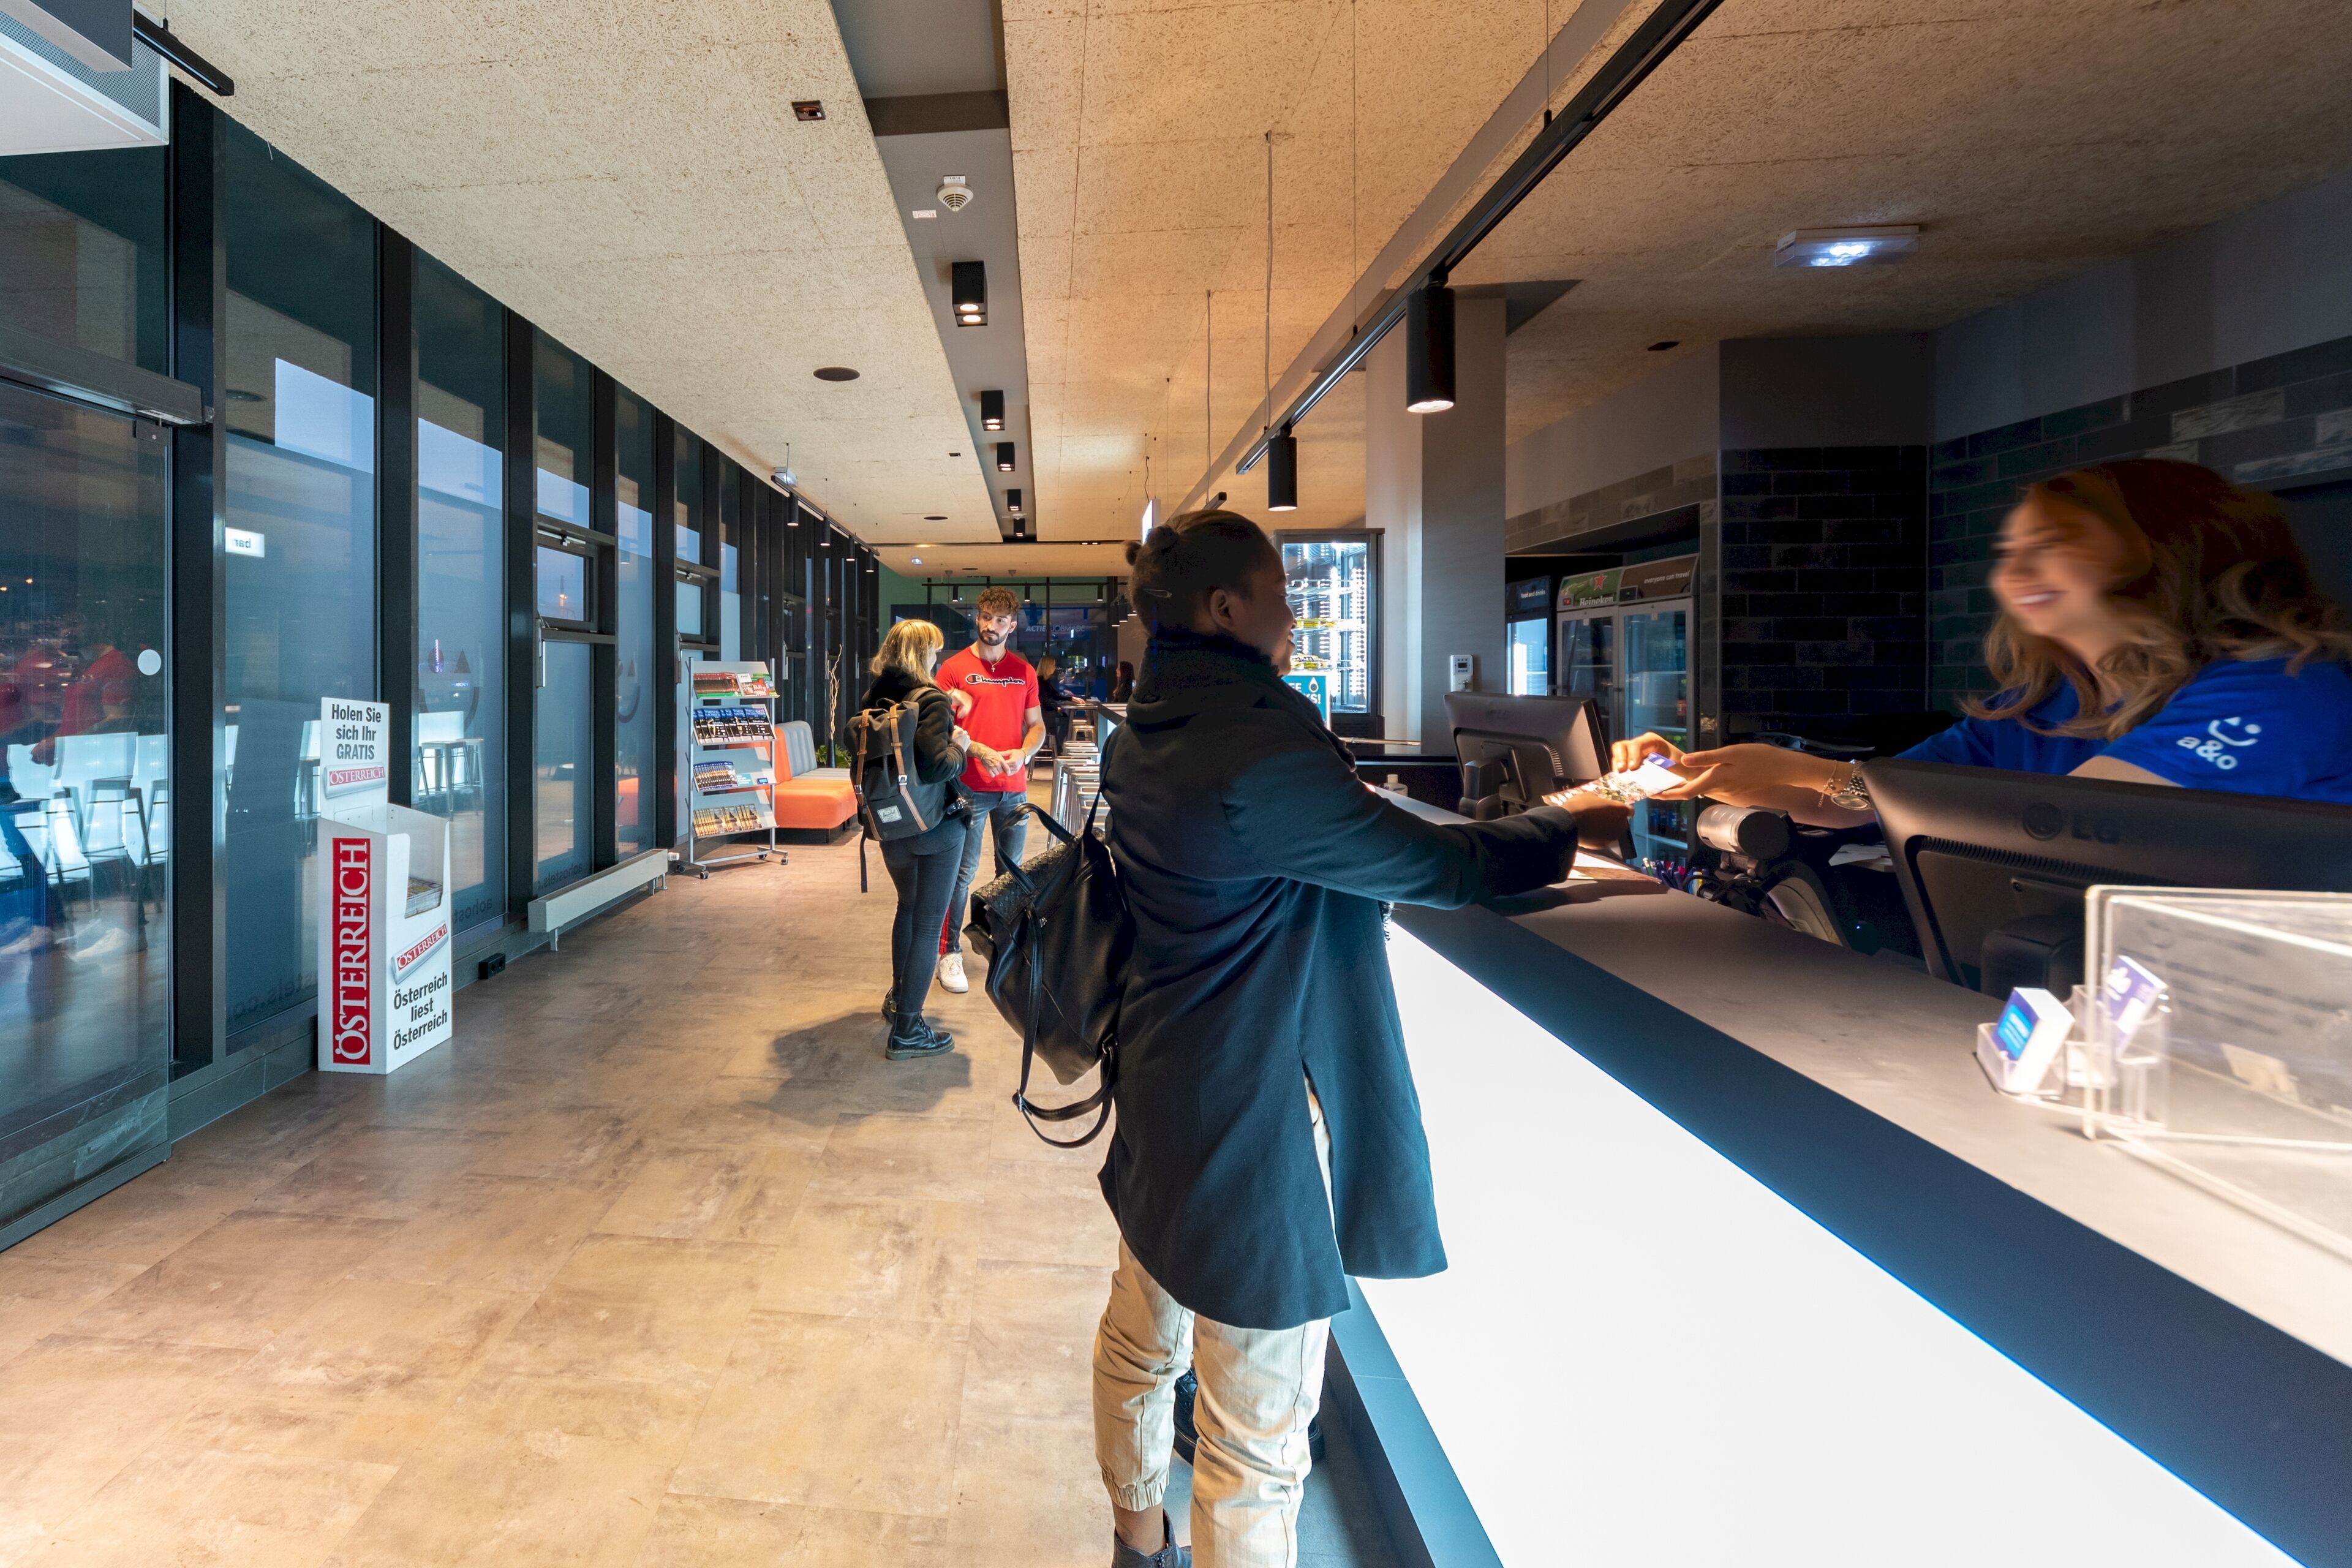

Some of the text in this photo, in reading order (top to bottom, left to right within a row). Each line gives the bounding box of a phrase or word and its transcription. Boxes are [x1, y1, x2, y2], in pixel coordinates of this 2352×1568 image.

[1676, 570, 1691, 579] travel
[1580, 595, 1613, 606] Heineken
[965, 674, 1025, 687] Champion
[331, 704, 381, 723] Holen Sie
[336, 725, 377, 741] sich Ihr
[336, 744, 375, 760] GRATIS
[2176, 736, 2239, 770] a&o
[330, 767, 385, 785] ÖSTERREICH
[2071, 813, 2120, 845] LG
[334, 842, 368, 1060] ÖSTERREICH
[398, 924, 448, 968] ÖSTERREICH
[394, 971, 448, 1010] Österreich
[410, 997, 434, 1022] liest
[393, 1009, 448, 1050] Österreich
